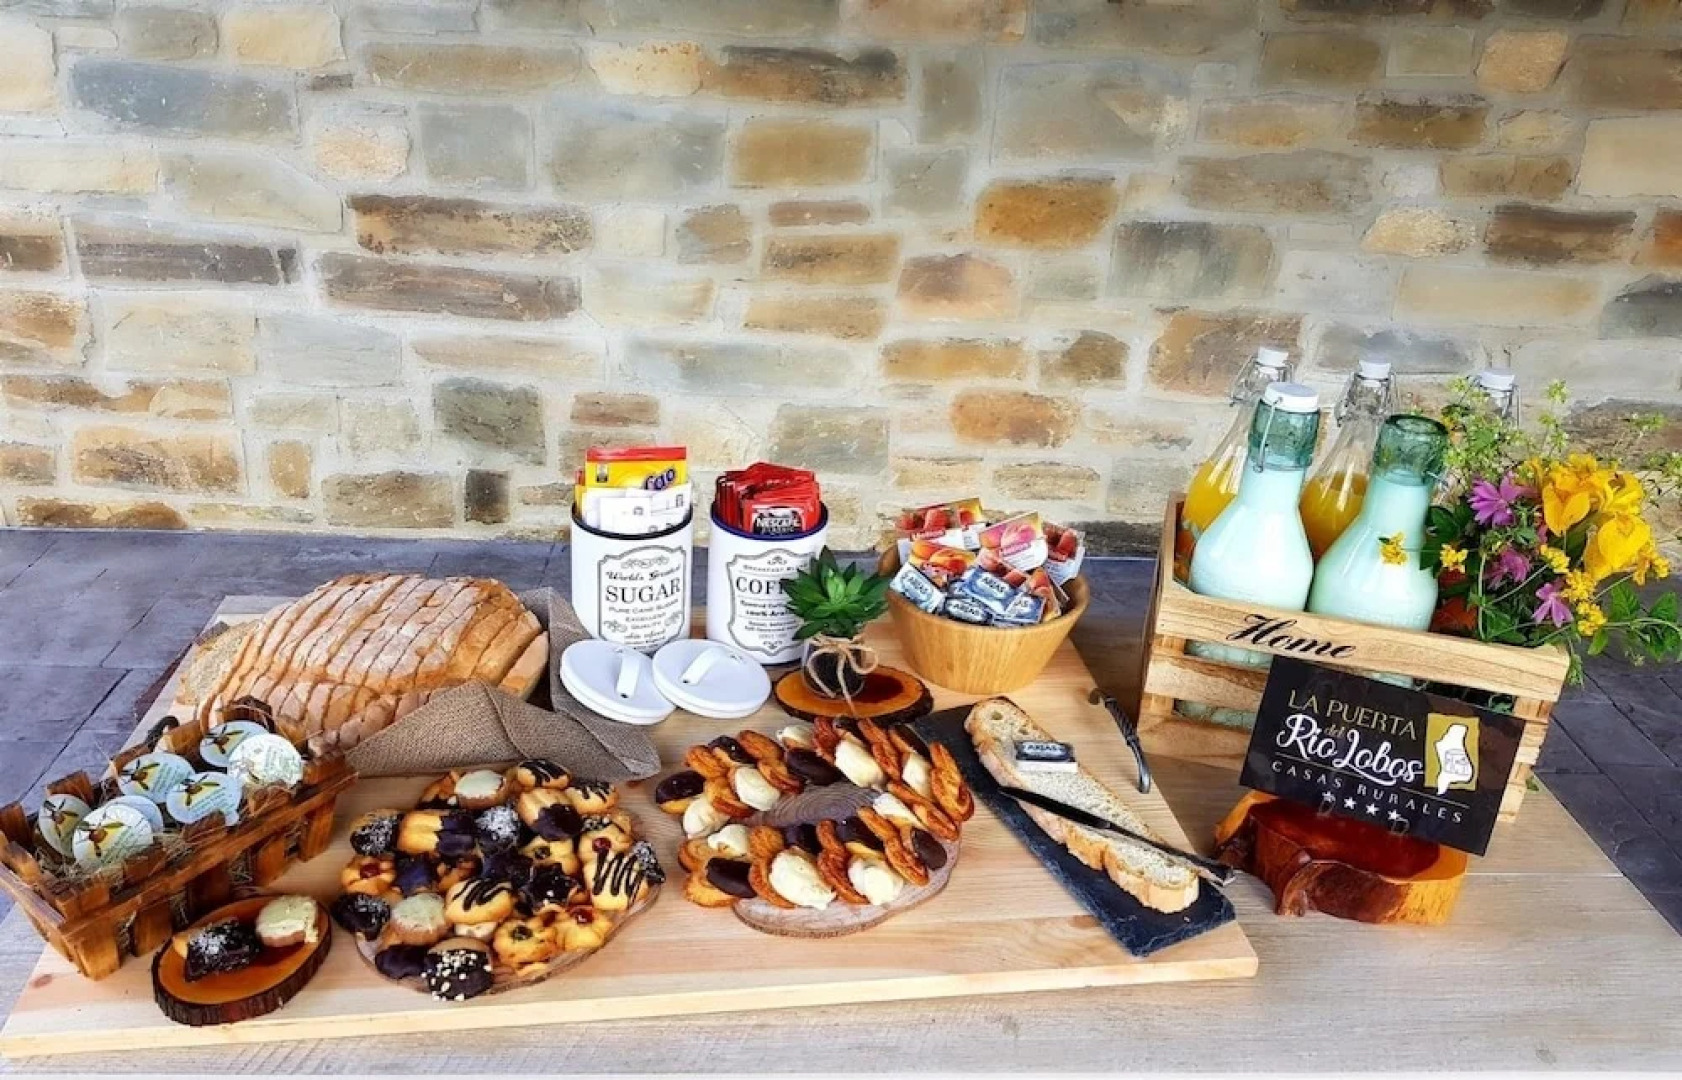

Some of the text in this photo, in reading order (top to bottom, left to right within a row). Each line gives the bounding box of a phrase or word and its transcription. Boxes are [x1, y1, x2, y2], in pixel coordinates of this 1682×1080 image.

[605, 577, 681, 604] SUGAR
[736, 576, 786, 595] COF
[1225, 613, 1357, 659] Home
[1287, 689, 1417, 741] LA PUERTA
[1324, 724, 1345, 739] del
[1332, 729, 1425, 787] Lobos
[1272, 760, 1464, 824] CASAS RURALES
